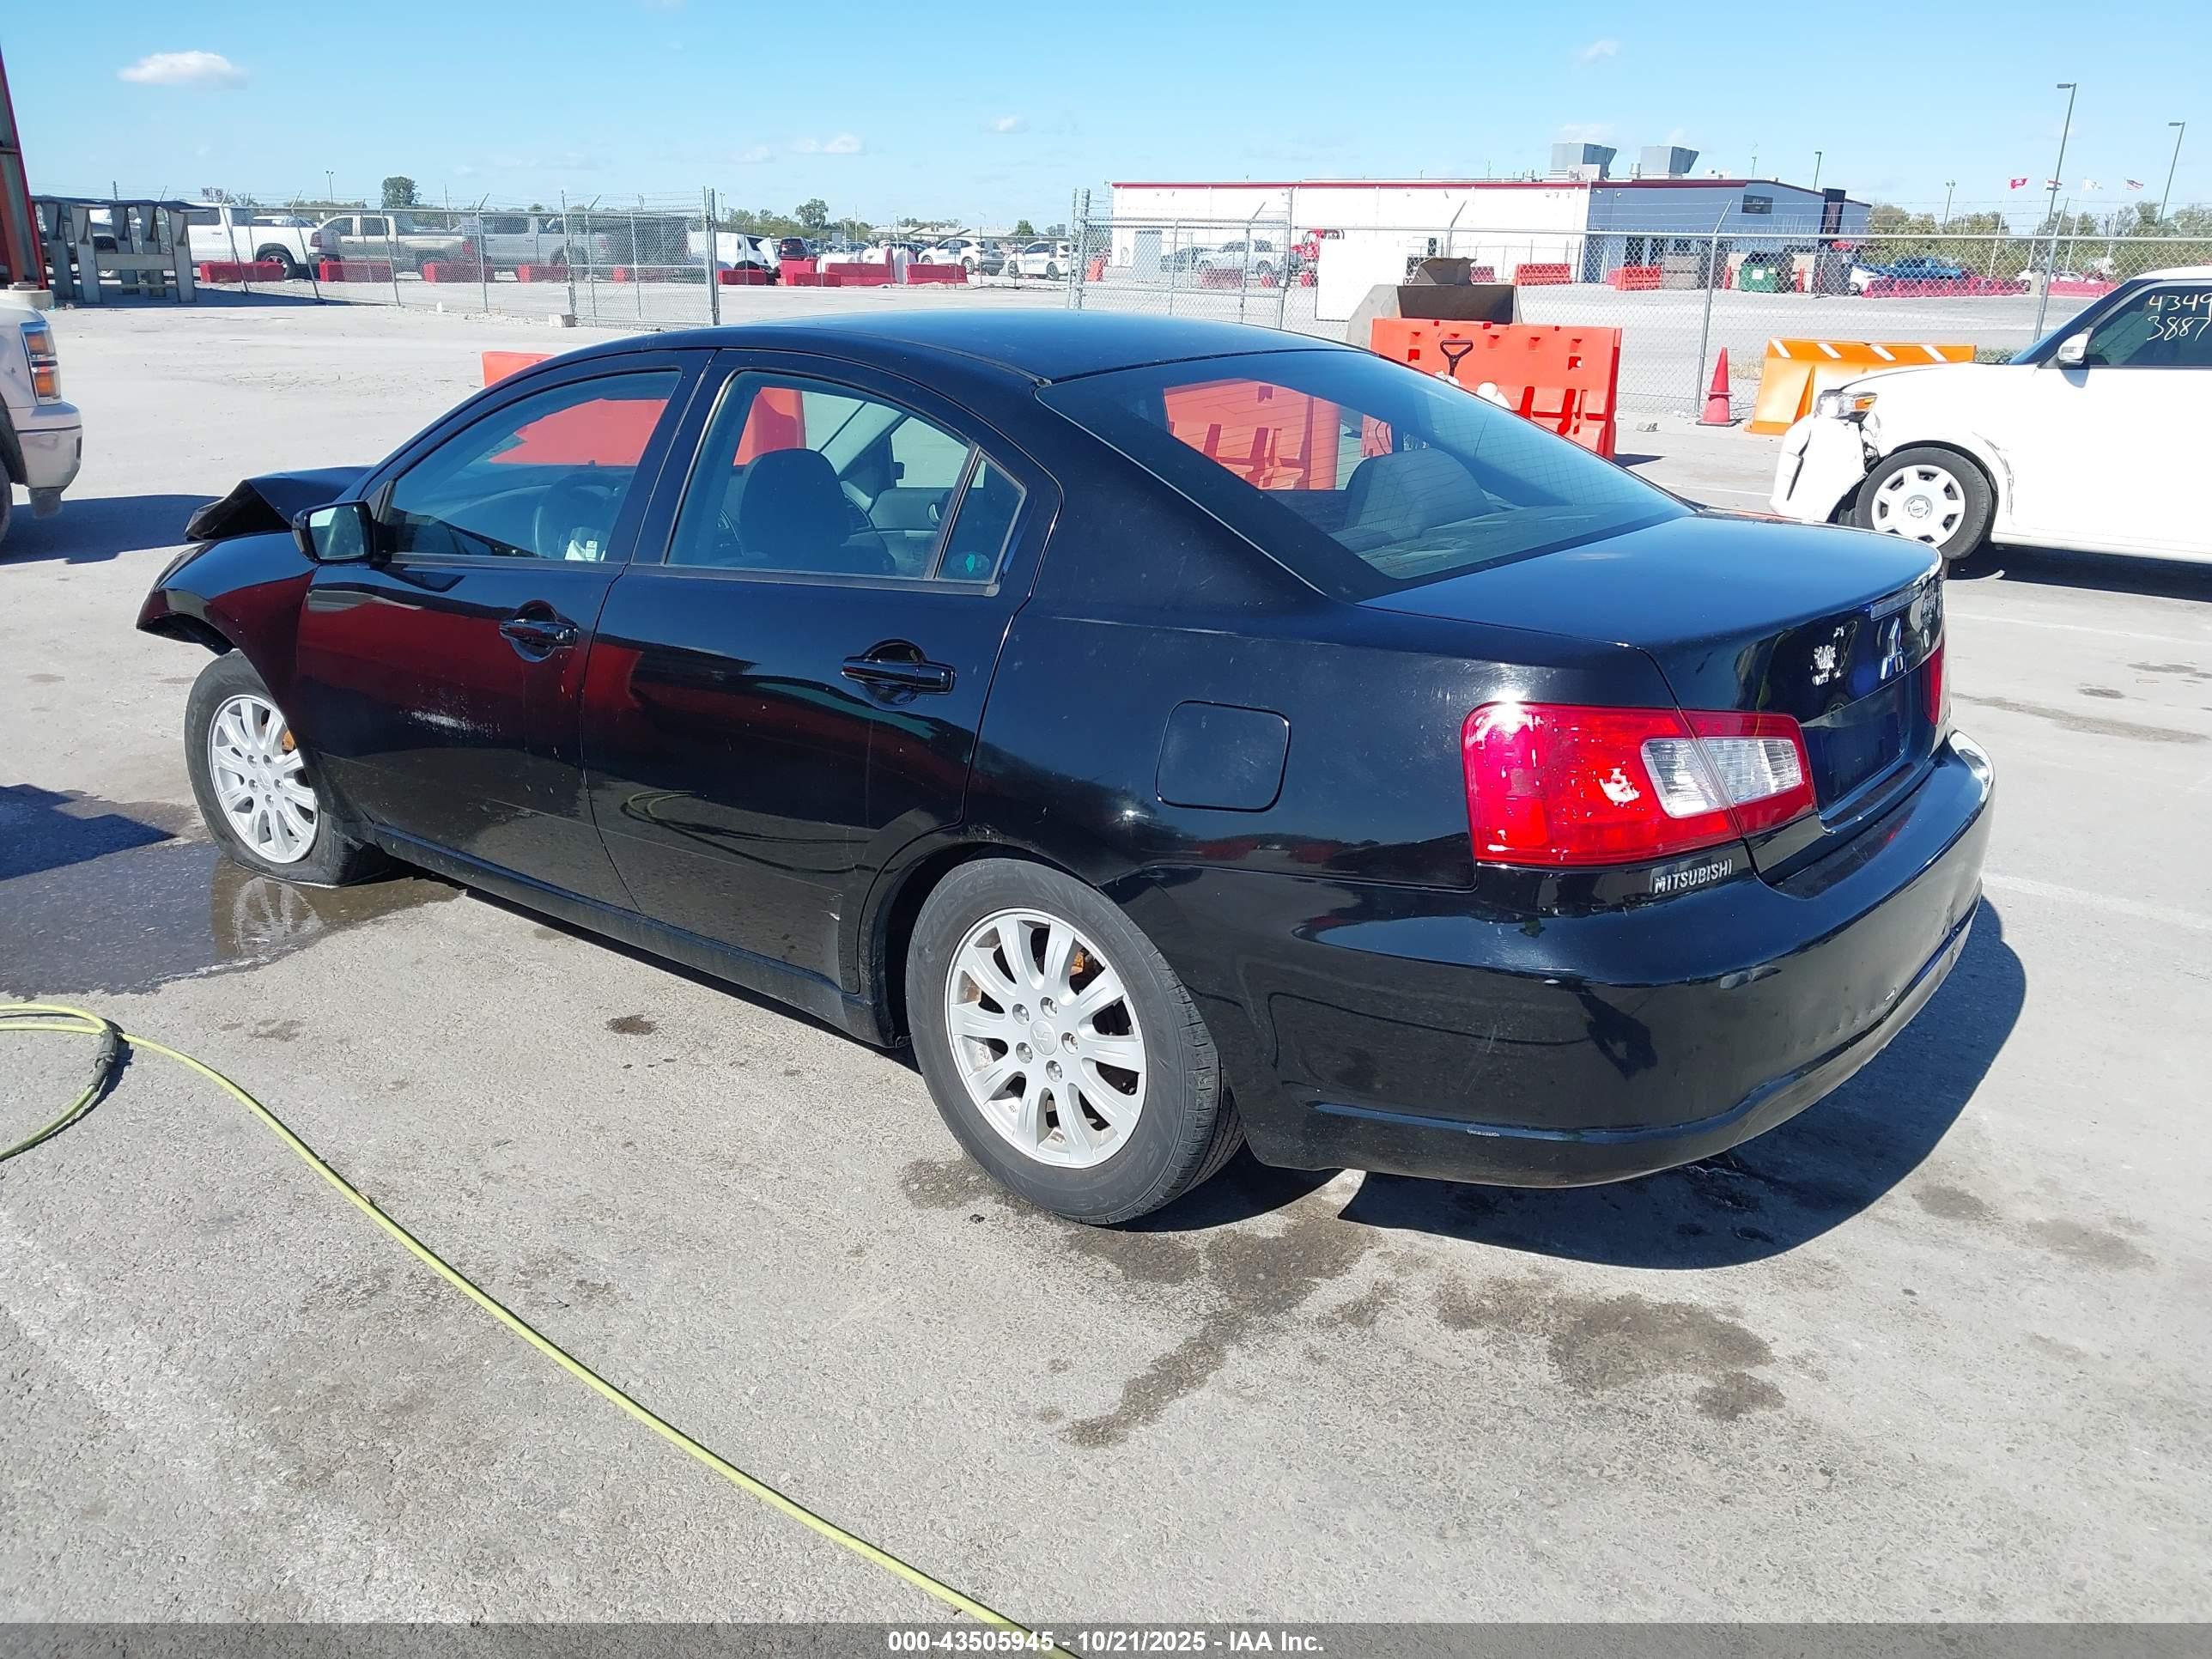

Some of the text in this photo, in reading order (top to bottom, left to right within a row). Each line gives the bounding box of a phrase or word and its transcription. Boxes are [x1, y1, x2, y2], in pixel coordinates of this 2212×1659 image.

[2148, 292, 2212, 320] 4349
[2147, 315, 2211, 342] 3887
[1654, 858, 1733, 894] MITSUBISHI
